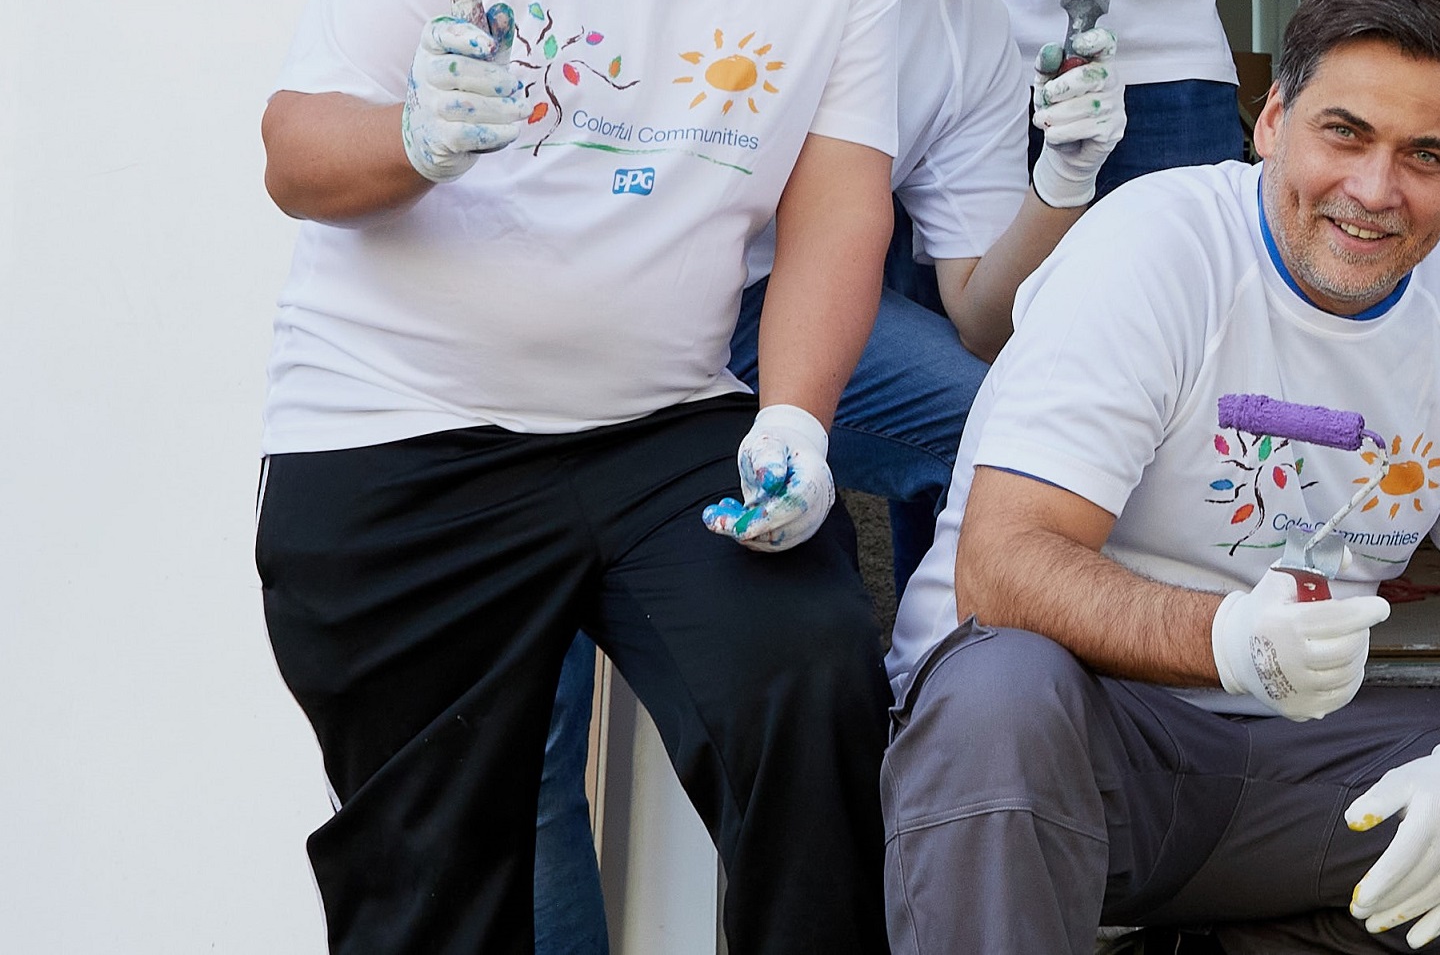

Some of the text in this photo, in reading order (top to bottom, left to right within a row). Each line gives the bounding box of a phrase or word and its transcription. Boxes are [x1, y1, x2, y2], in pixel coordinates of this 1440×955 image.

[572, 109, 760, 150] Colorful Communities
[613, 169, 654, 195] PPG
